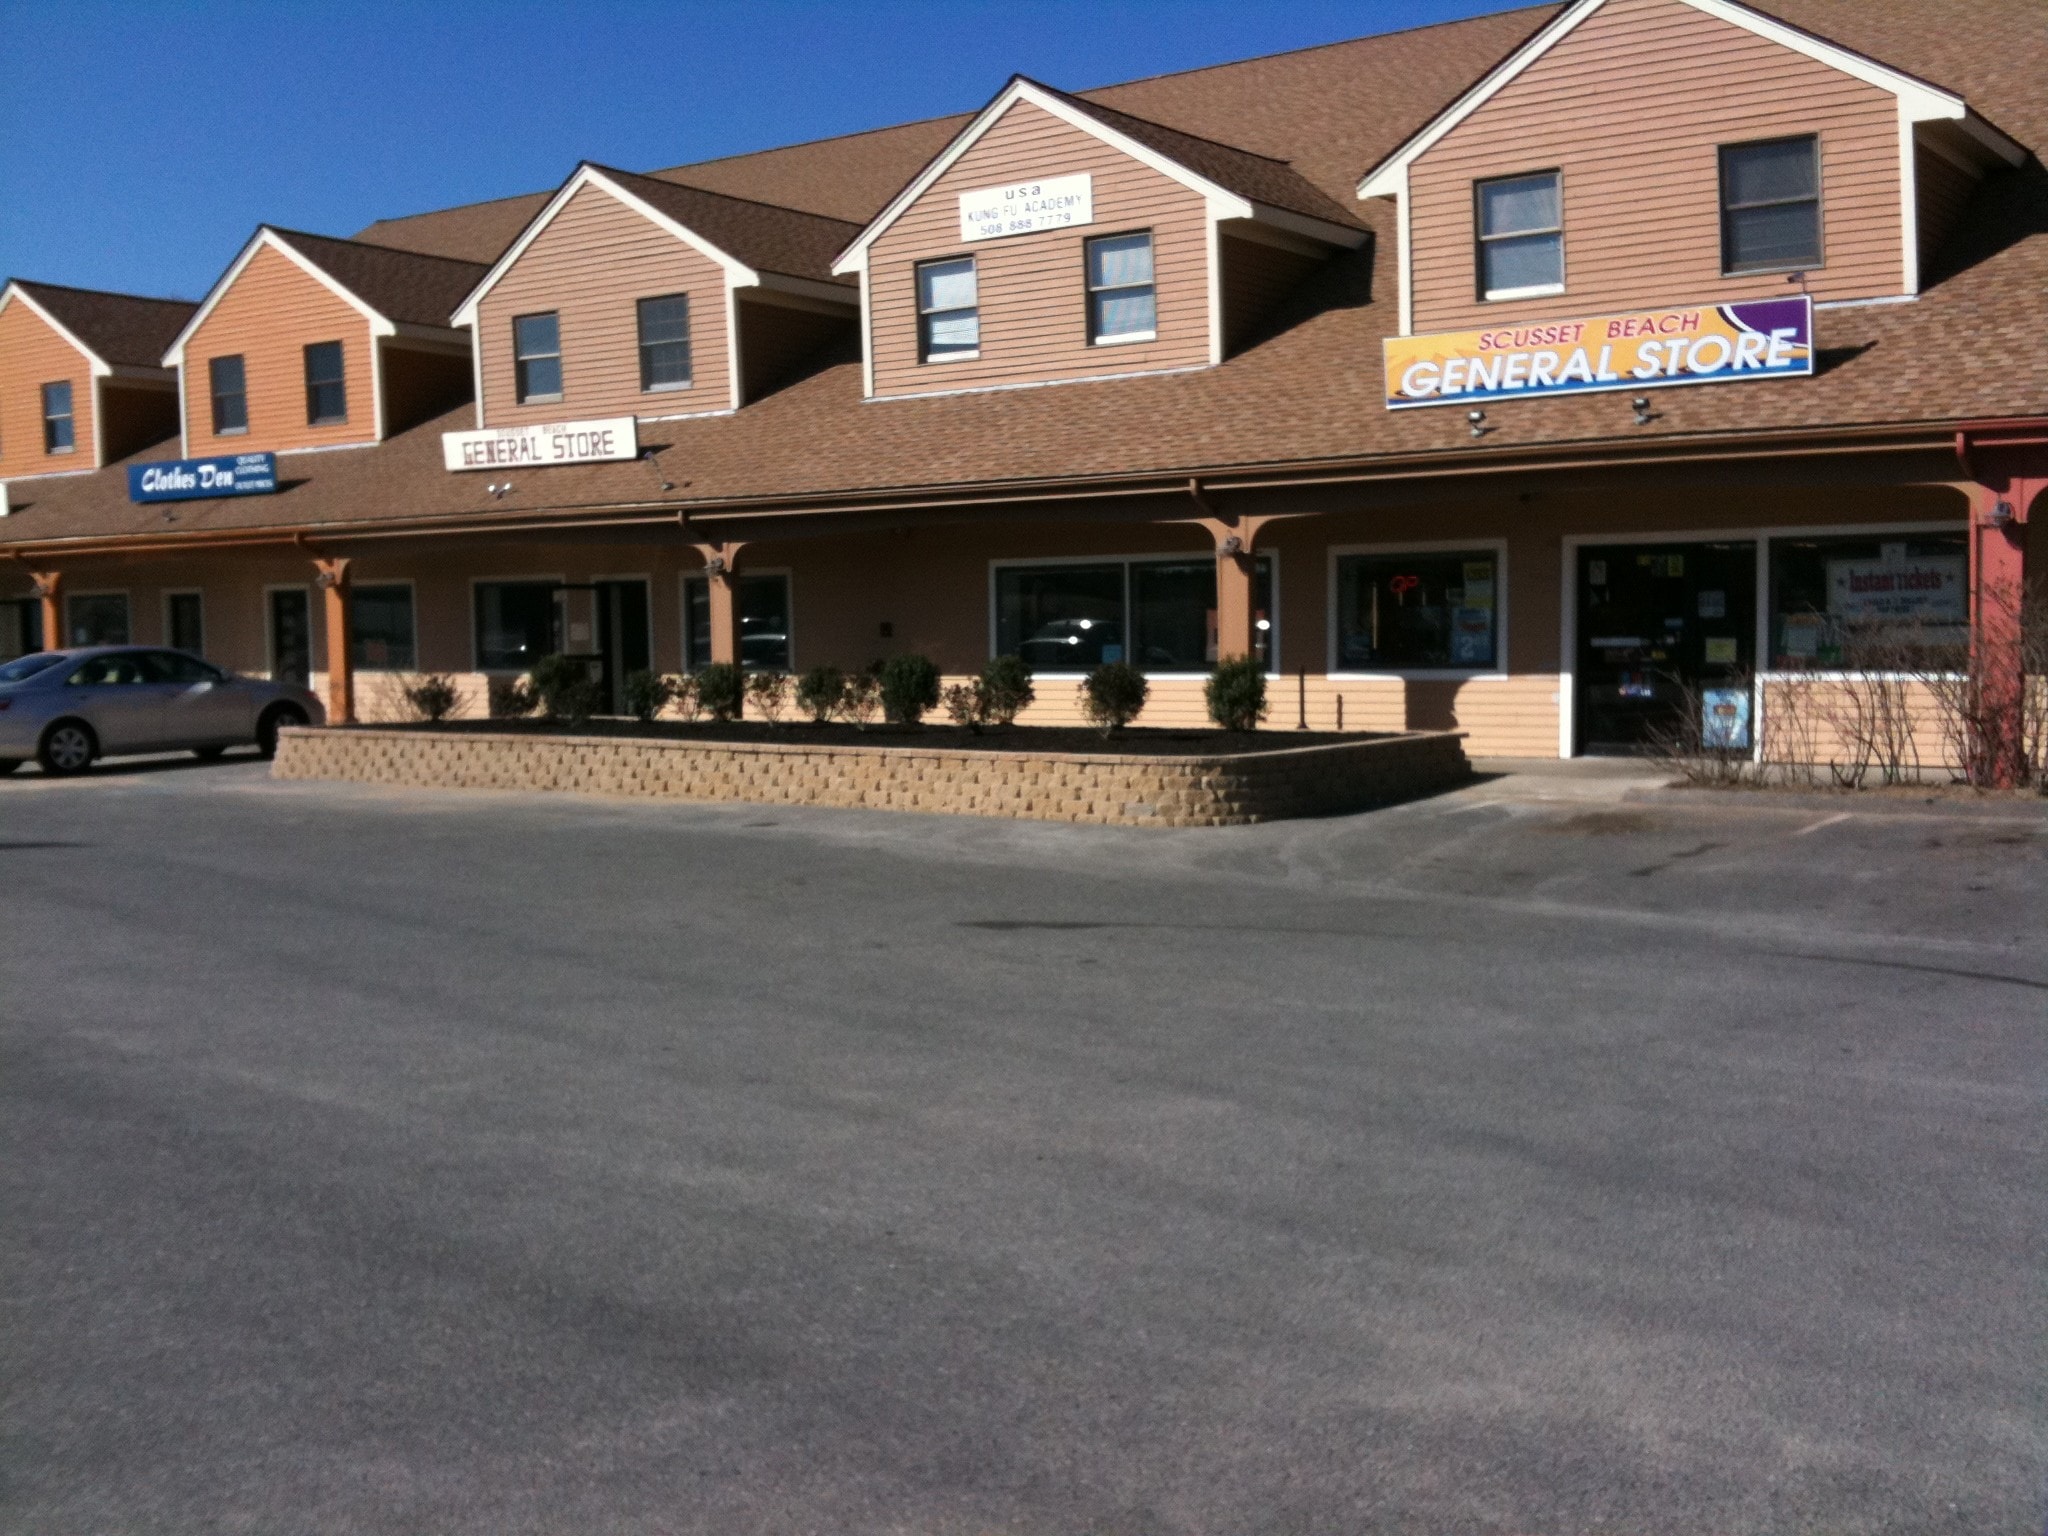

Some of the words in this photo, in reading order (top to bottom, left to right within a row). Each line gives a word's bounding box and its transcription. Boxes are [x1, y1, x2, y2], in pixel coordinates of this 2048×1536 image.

[968, 207, 999, 222] KUNG
[1003, 204, 1017, 217] FU
[1024, 194, 1082, 213] ACADEMY
[980, 223, 1003, 235] 508
[1038, 213, 1071, 226] 7779
[1477, 322, 1586, 352] SCUSSET
[1606, 312, 1700, 339] BEACH
[1400, 343, 1619, 398] GENERAL
[1632, 326, 1798, 378] STORE
[462, 436, 542, 466] GENERAL
[552, 430, 615, 459] STORE
[141, 466, 196, 492] Clothes
[198, 463, 234, 489] Den
